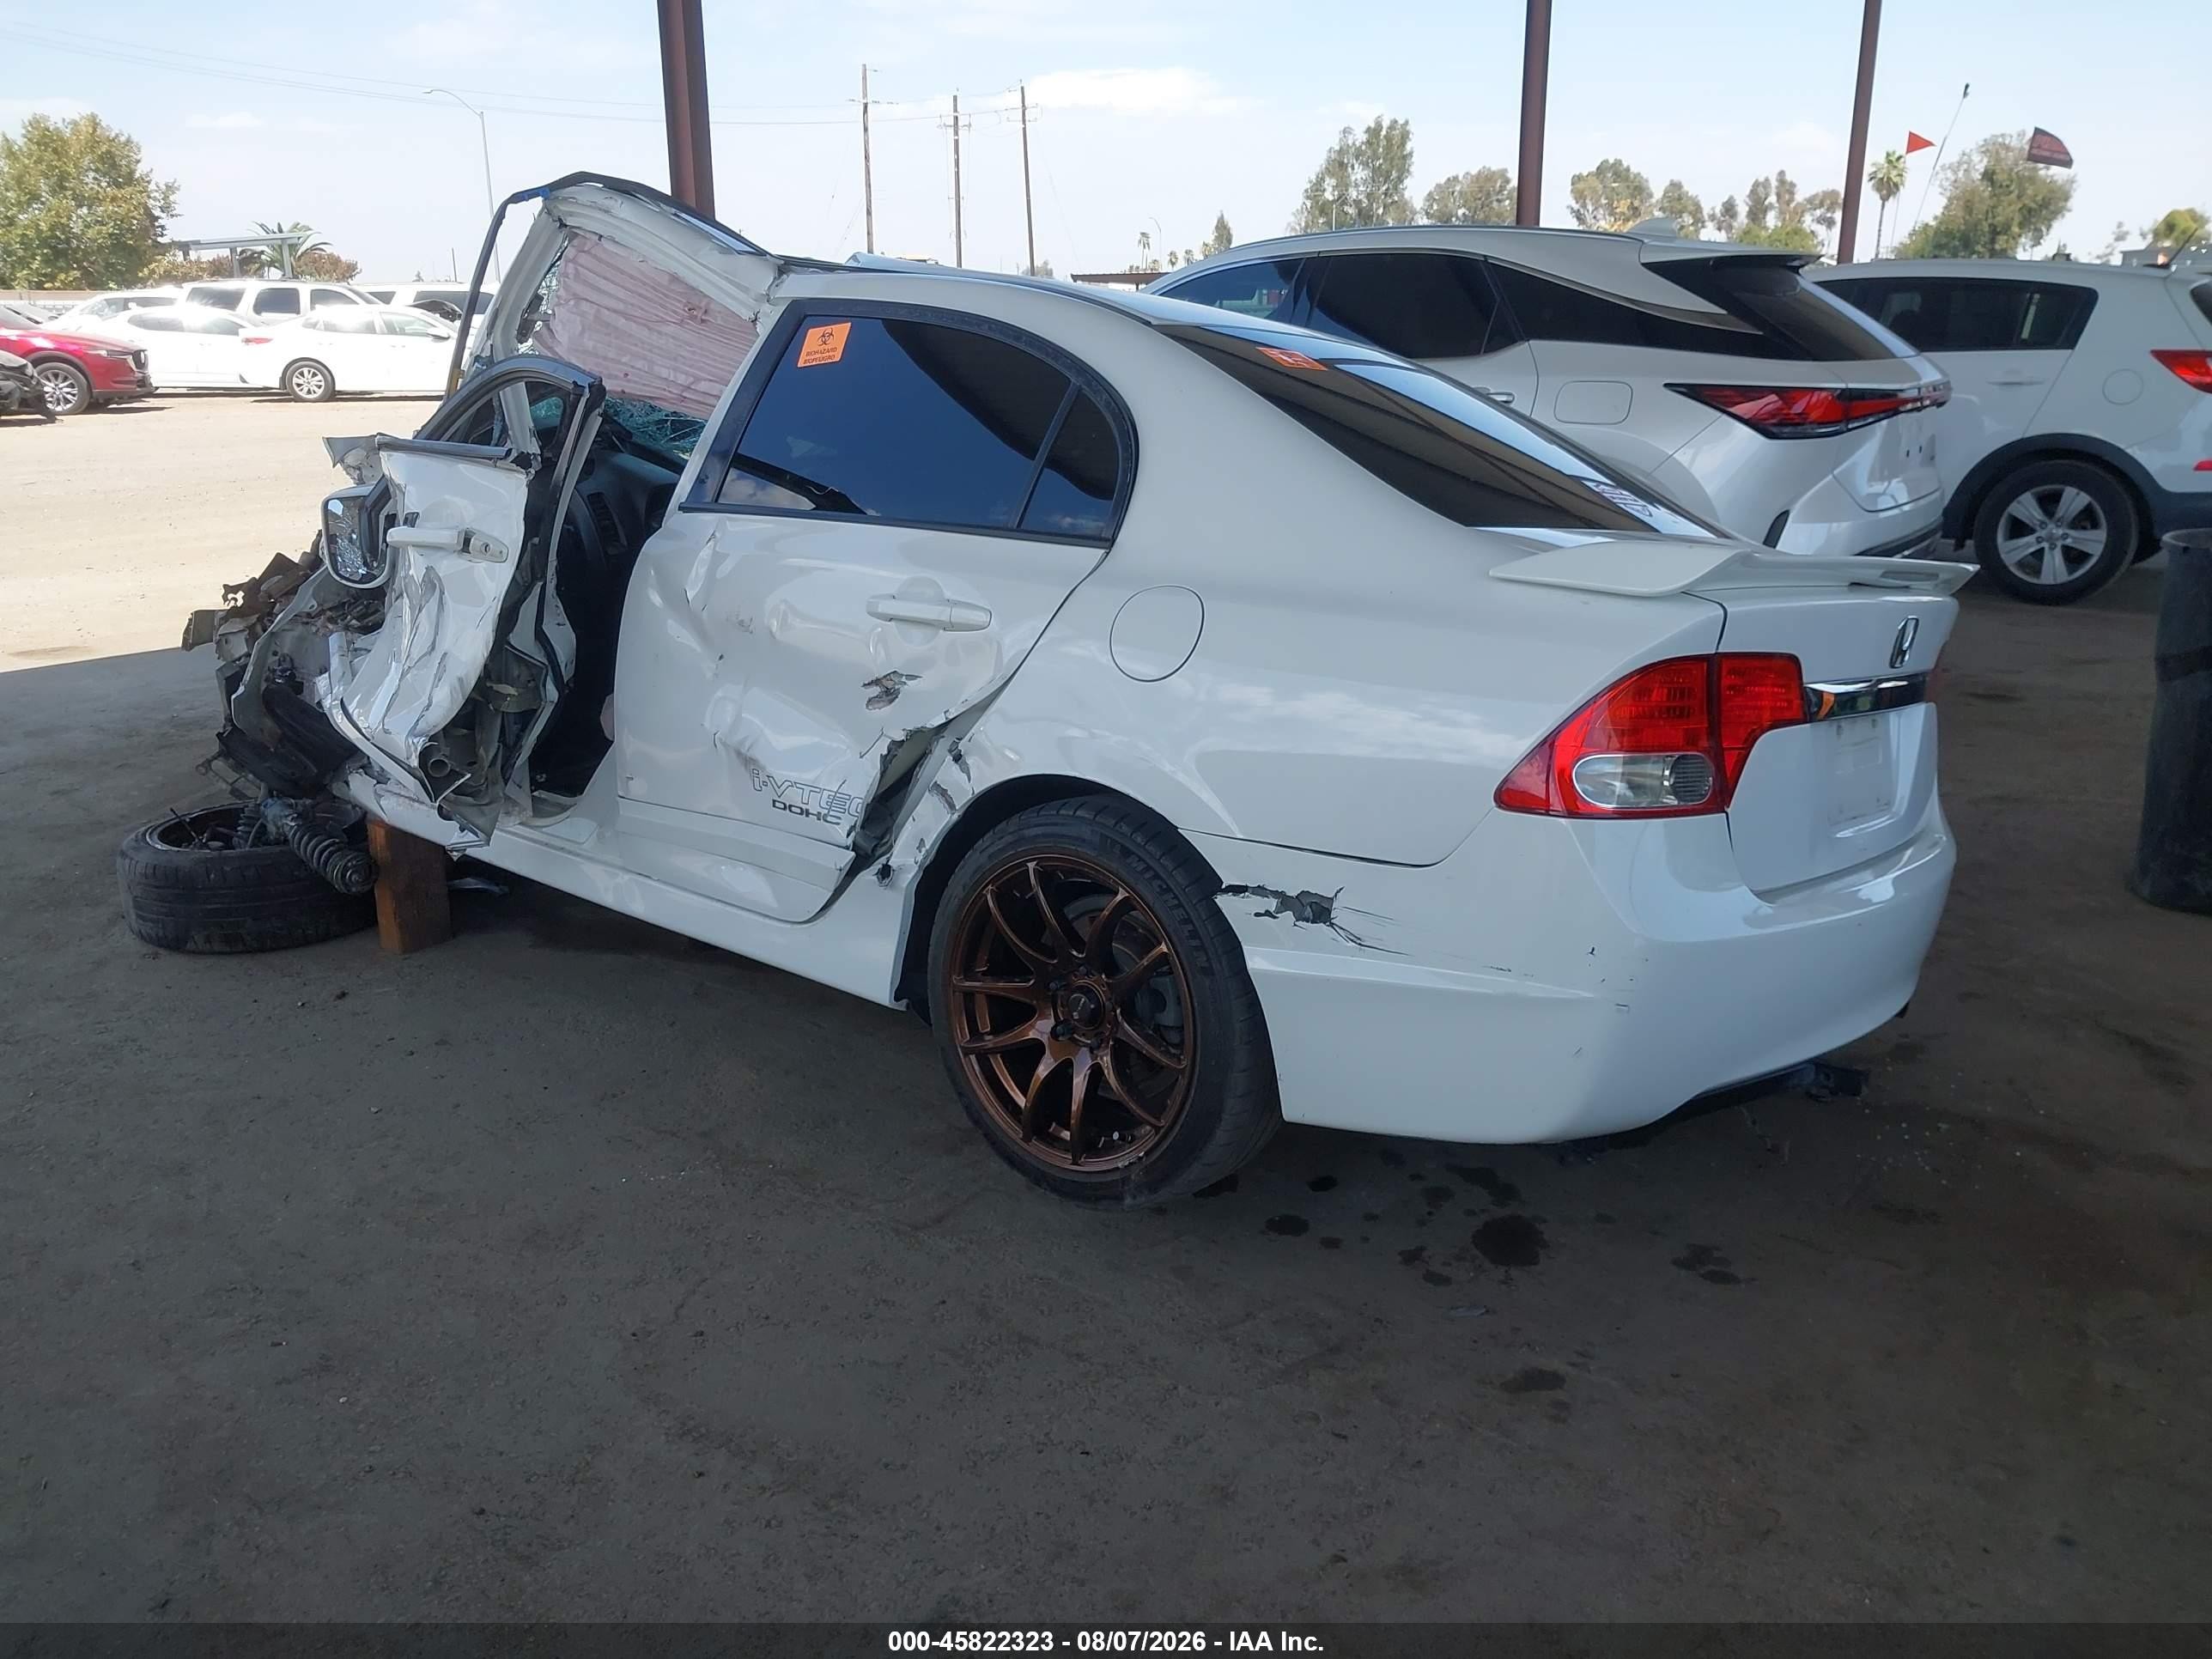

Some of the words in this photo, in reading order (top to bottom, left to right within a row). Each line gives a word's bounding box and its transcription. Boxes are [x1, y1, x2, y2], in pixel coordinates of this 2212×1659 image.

[805, 347, 837, 356] BIOHAZARD
[772, 799, 842, 825] DOHC
[1124, 854, 1210, 969] MICHELIN
